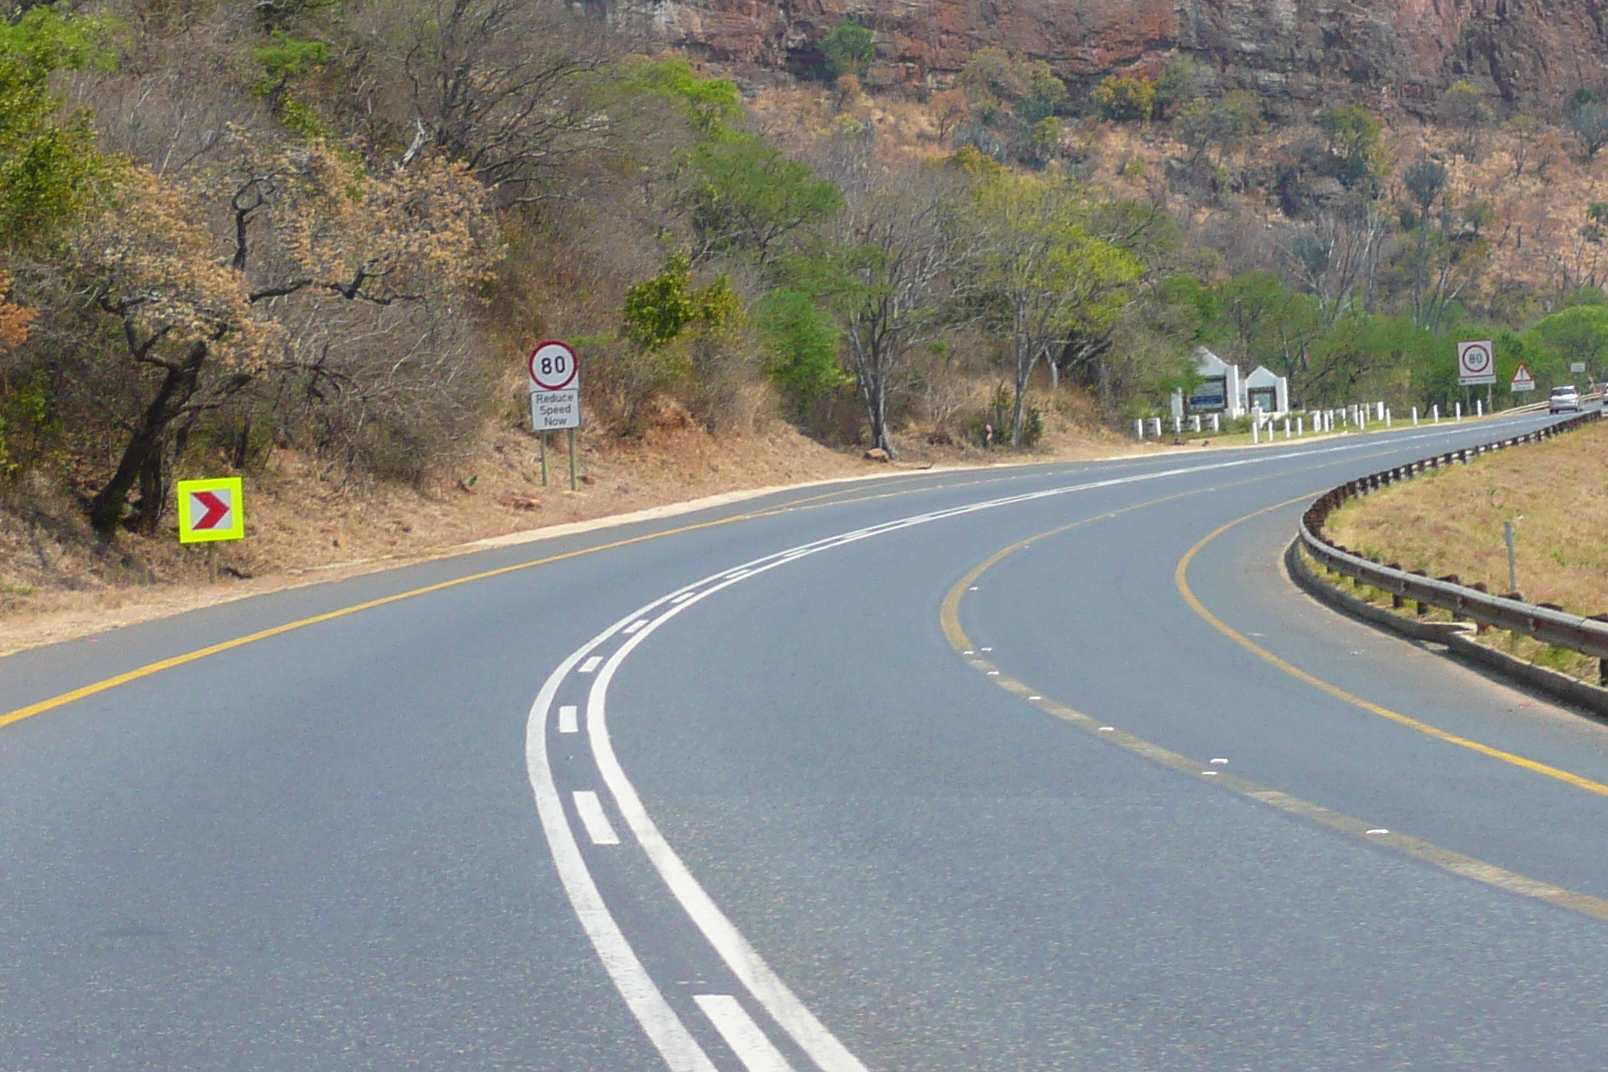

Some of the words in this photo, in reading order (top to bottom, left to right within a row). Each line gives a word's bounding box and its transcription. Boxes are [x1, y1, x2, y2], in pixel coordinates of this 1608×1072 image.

[541, 355, 565, 375] 80
[536, 393, 574, 404] Reduce
[539, 404, 571, 416] Speed
[544, 417, 567, 426] Now
